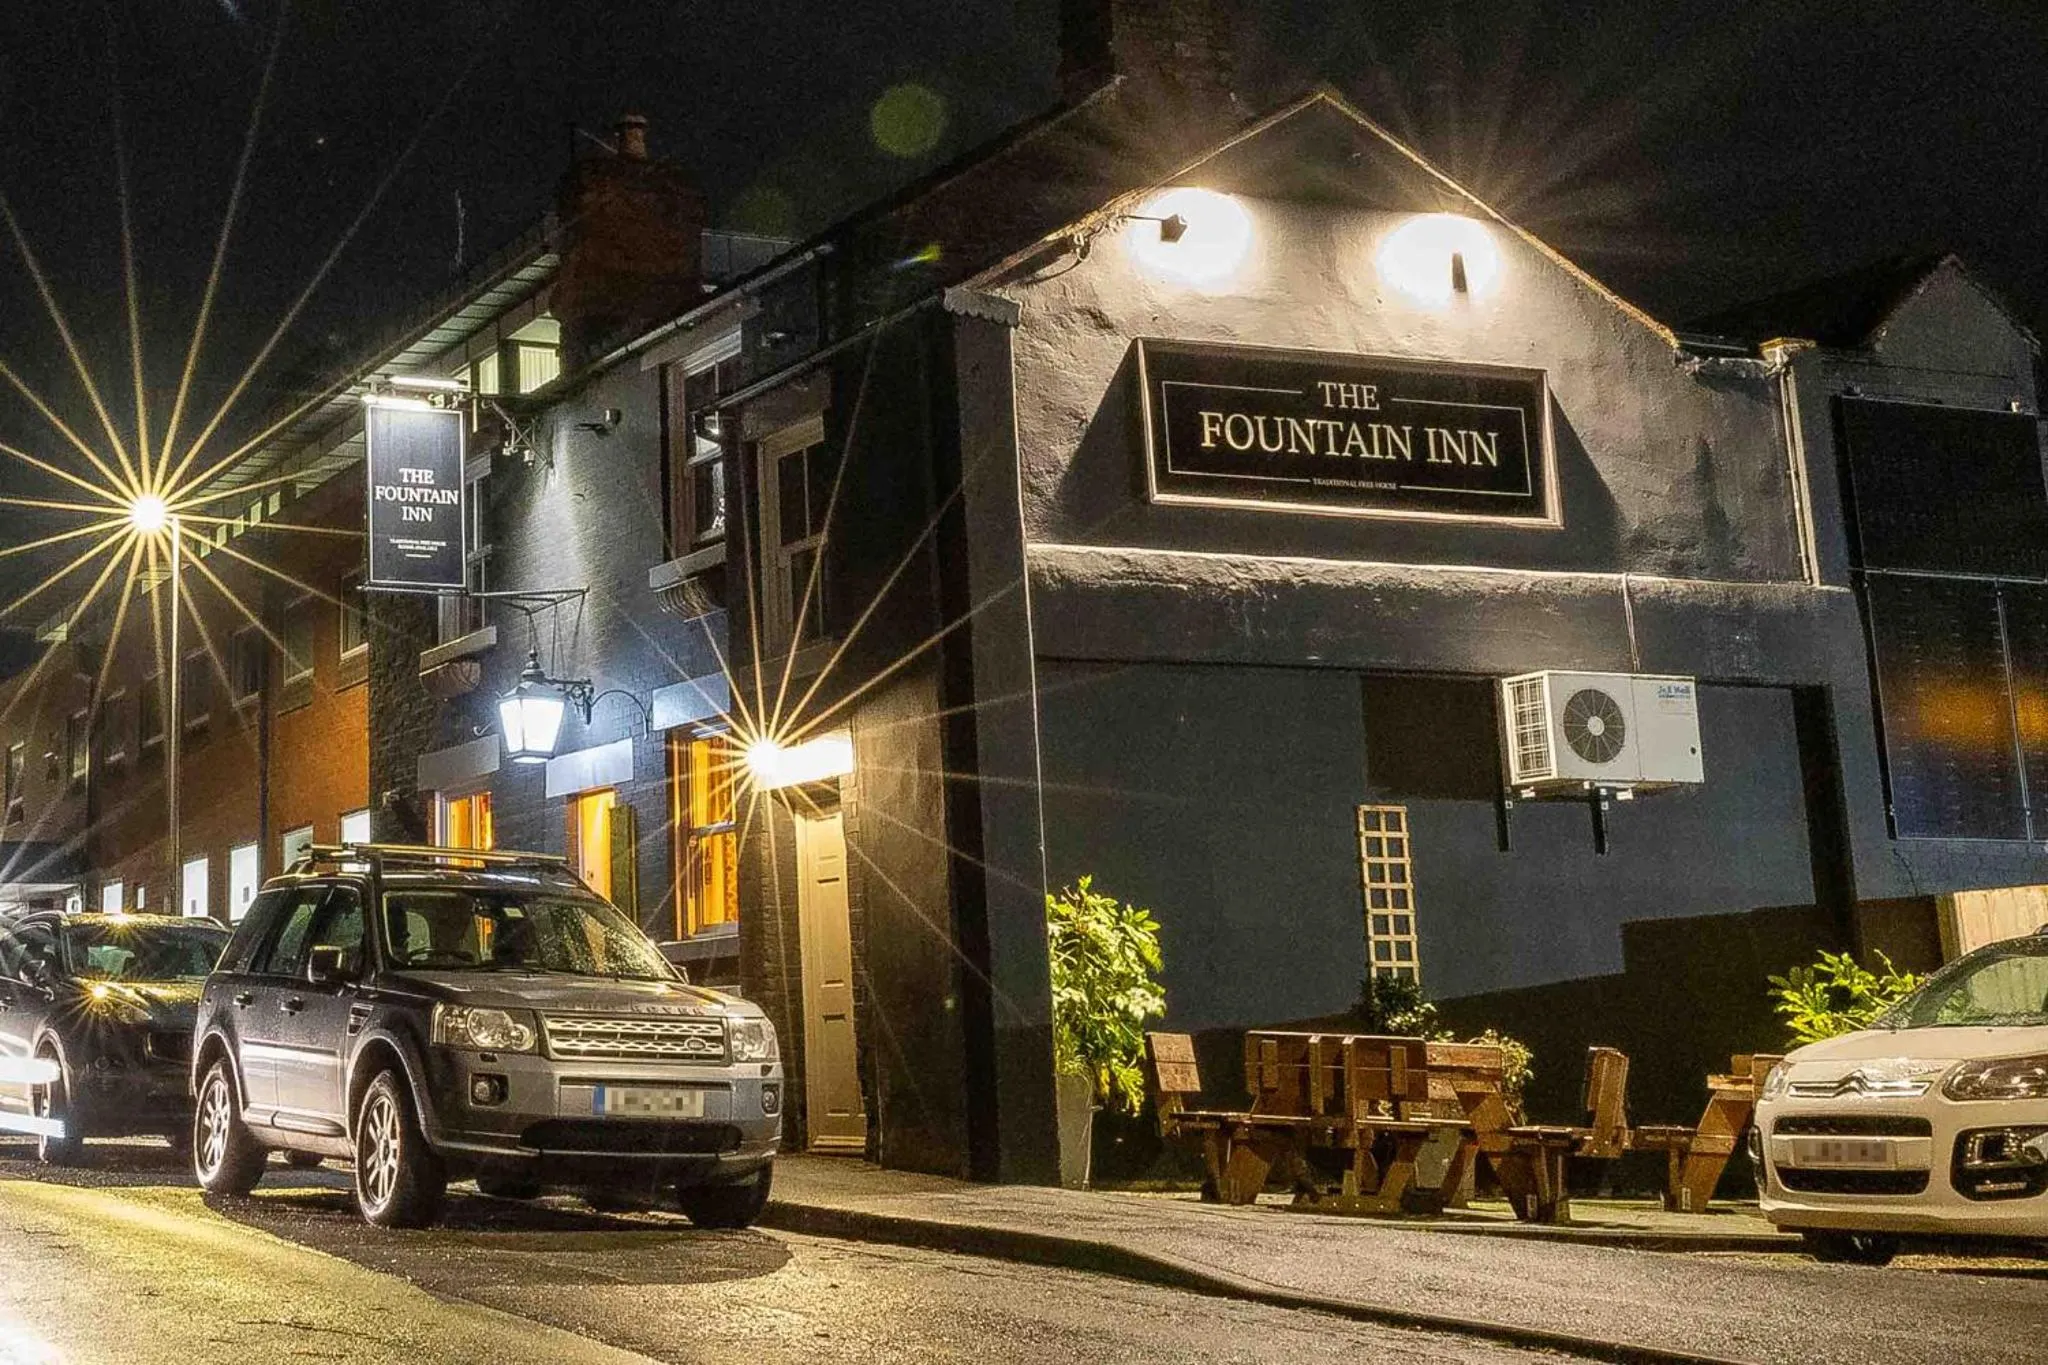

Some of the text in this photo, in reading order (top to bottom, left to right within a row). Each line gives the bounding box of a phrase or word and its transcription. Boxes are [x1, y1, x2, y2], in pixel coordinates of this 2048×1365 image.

[1318, 381, 1379, 410] THE
[1198, 411, 1499, 467] FOUNTAIN INN
[399, 467, 435, 484] THE
[374, 485, 459, 505] FOUNTAIN
[401, 505, 433, 522] INN
